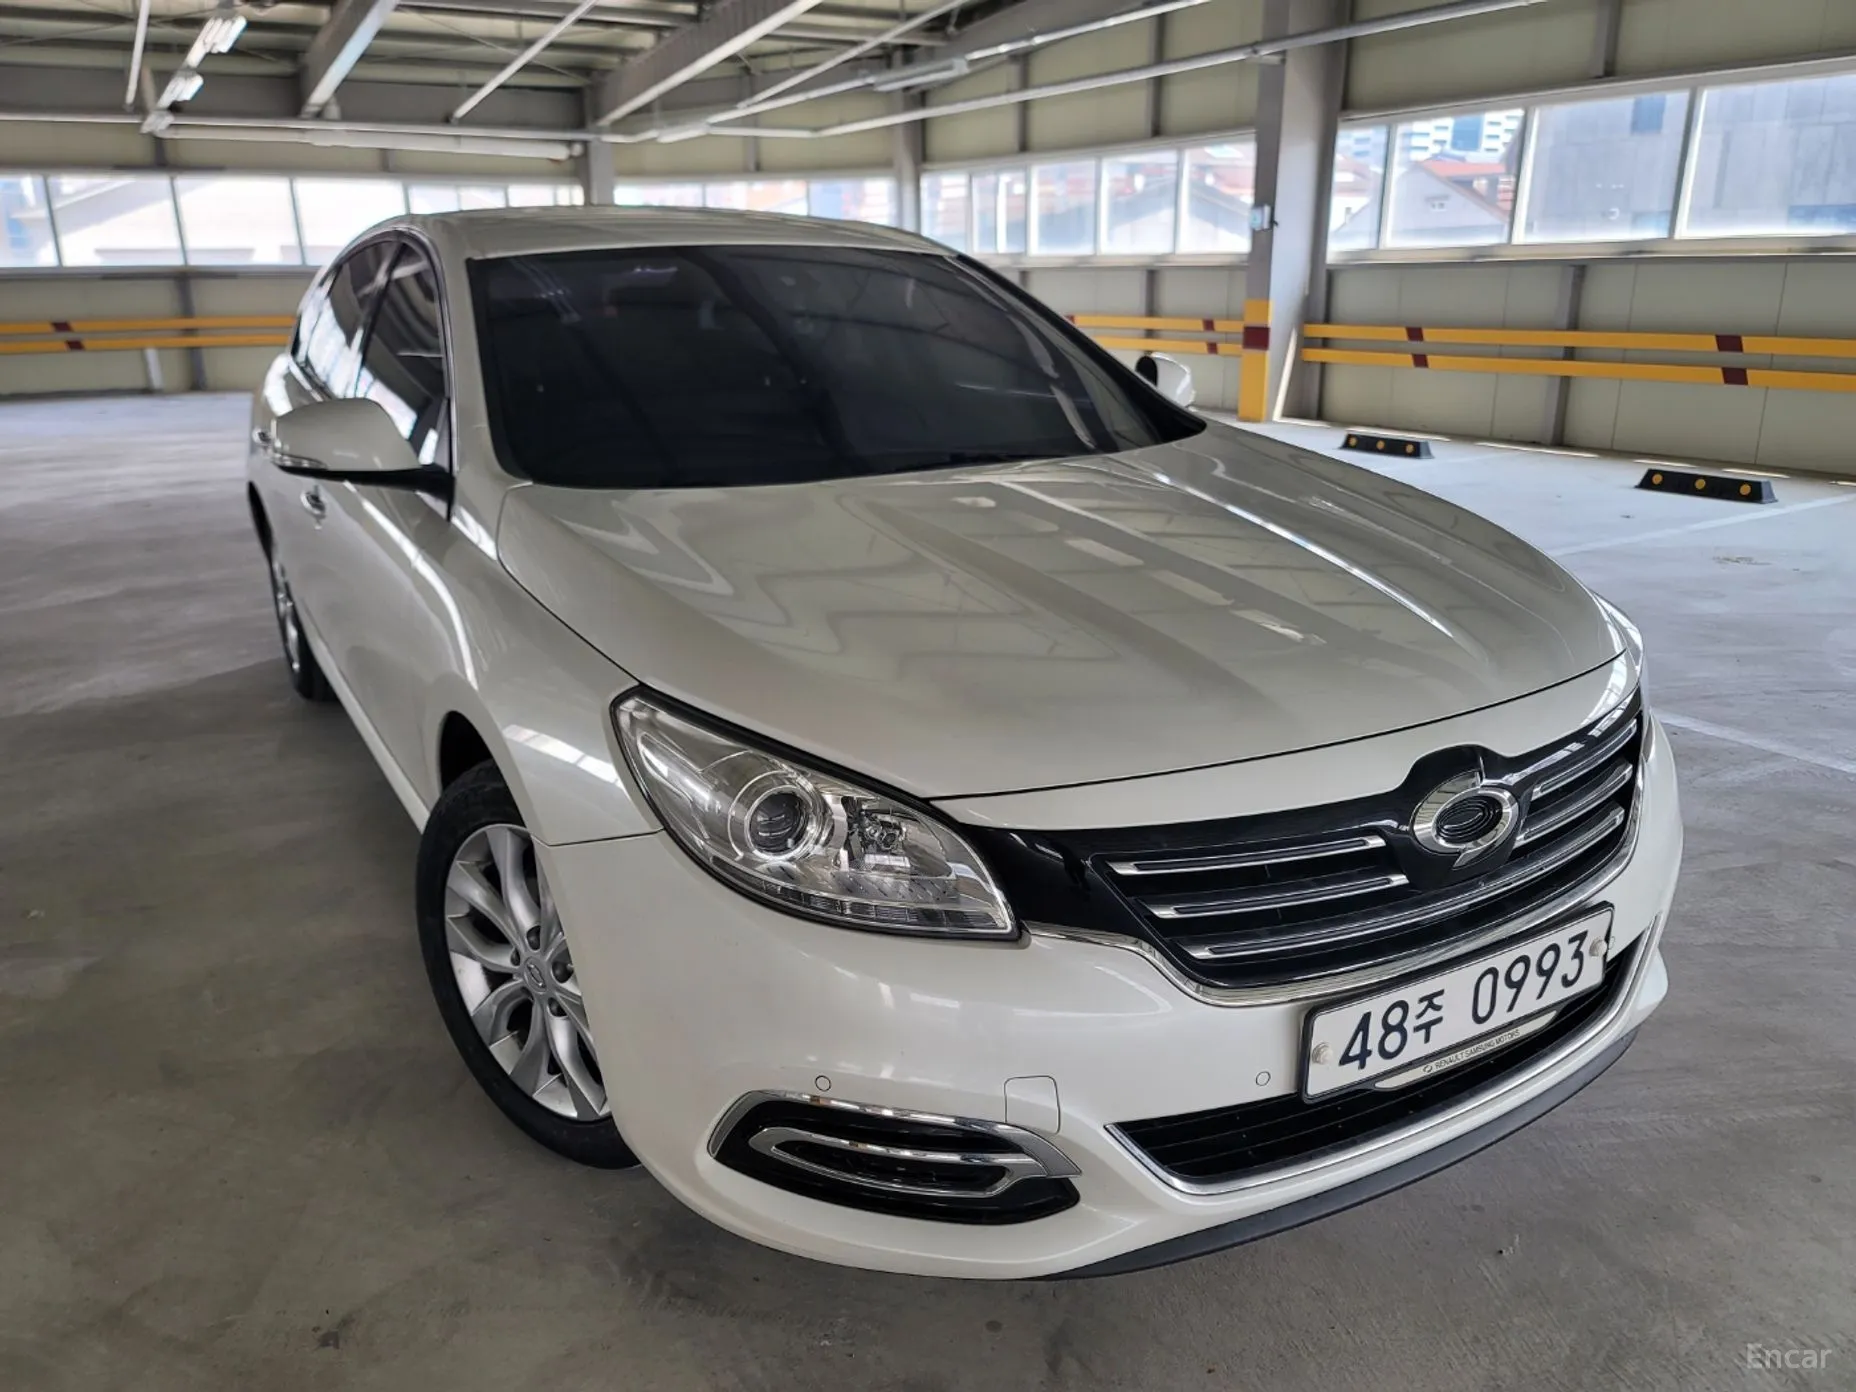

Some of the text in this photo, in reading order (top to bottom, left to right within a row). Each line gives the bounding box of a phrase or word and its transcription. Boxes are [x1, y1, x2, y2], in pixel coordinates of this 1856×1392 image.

[1338, 930, 1589, 1070] 48주 0993
[1434, 1029, 1521, 1069] RENAULT SAMSUNG MOTORS
